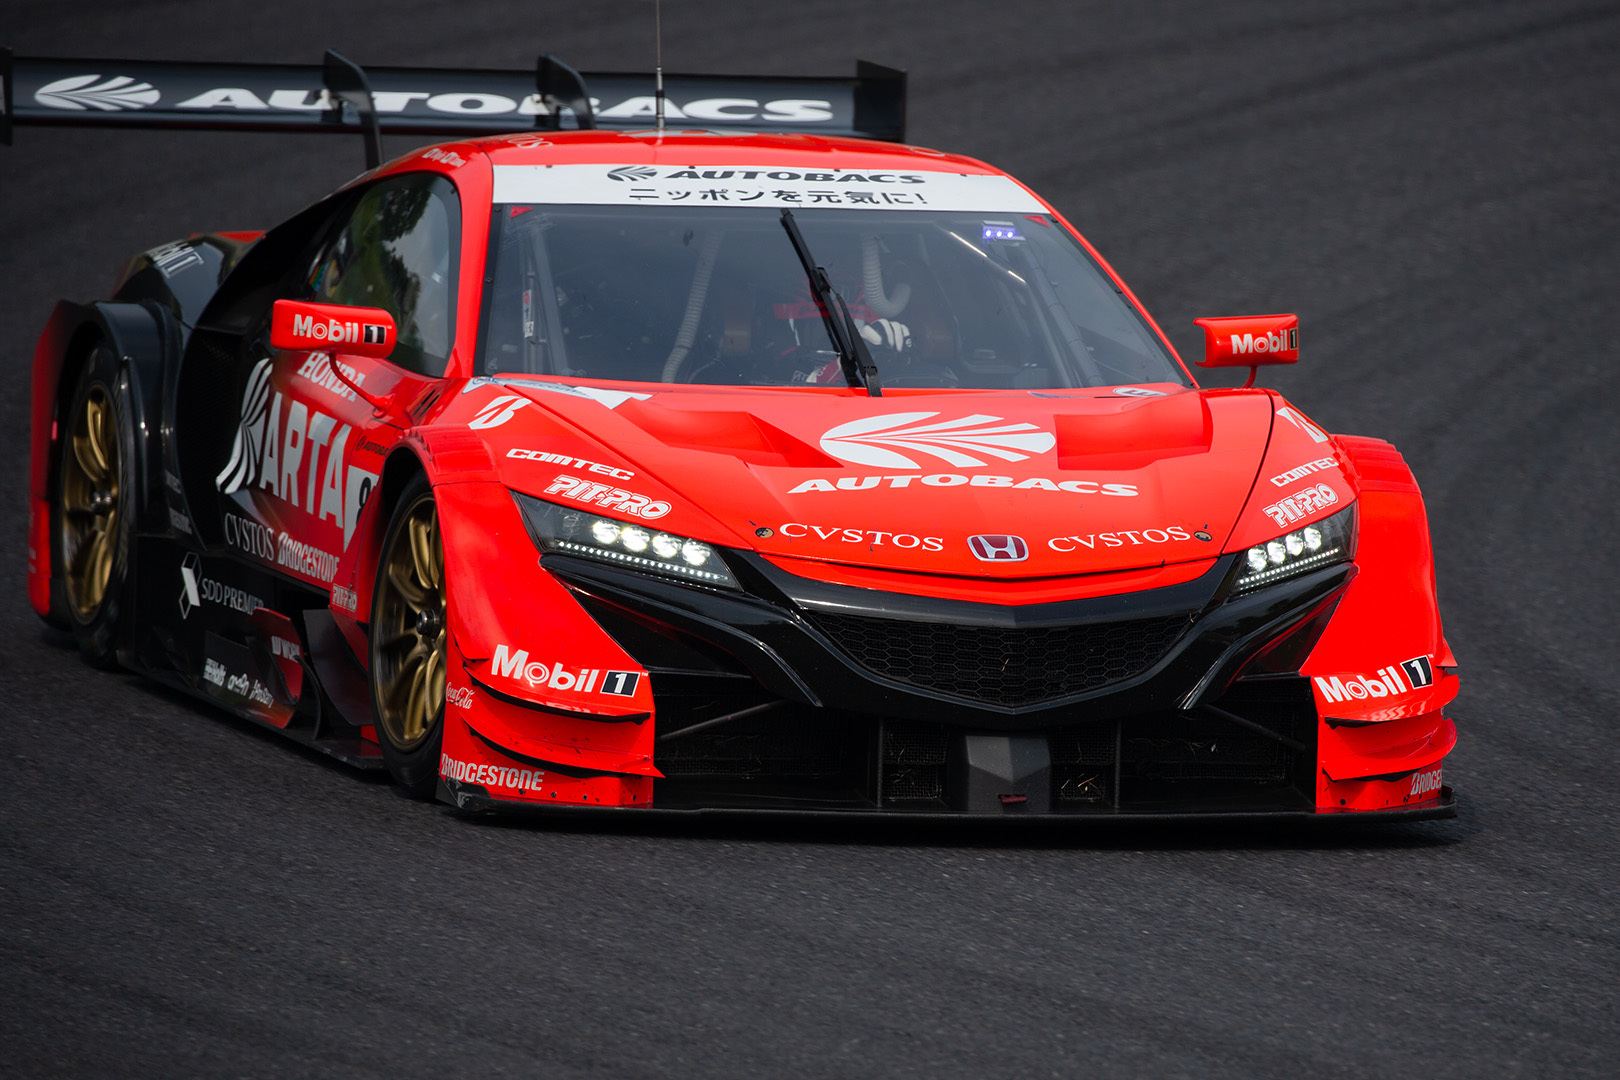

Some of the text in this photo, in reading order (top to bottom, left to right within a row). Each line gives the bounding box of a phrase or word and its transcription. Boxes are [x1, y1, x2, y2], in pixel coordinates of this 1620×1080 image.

[665, 169, 926, 184] AUTOBACS
[293, 313, 358, 343] Mobil
[1230, 330, 1288, 355] Mobil
[297, 351, 367, 402] HONDA
[259, 391, 353, 530] ARTA
[506, 448, 635, 481] COMTEC
[1270, 457, 1340, 487] COMTEC
[787, 474, 1139, 497] AUTOBACS
[224, 512, 275, 561] CVSTOS
[779, 522, 945, 552] CVSTOS
[1047, 525, 1191, 552] CVSTOS
[491, 643, 600, 693] Mobil
[1314, 666, 1407, 703] Mobil
[441, 752, 545, 791] BRIDGESTONE
